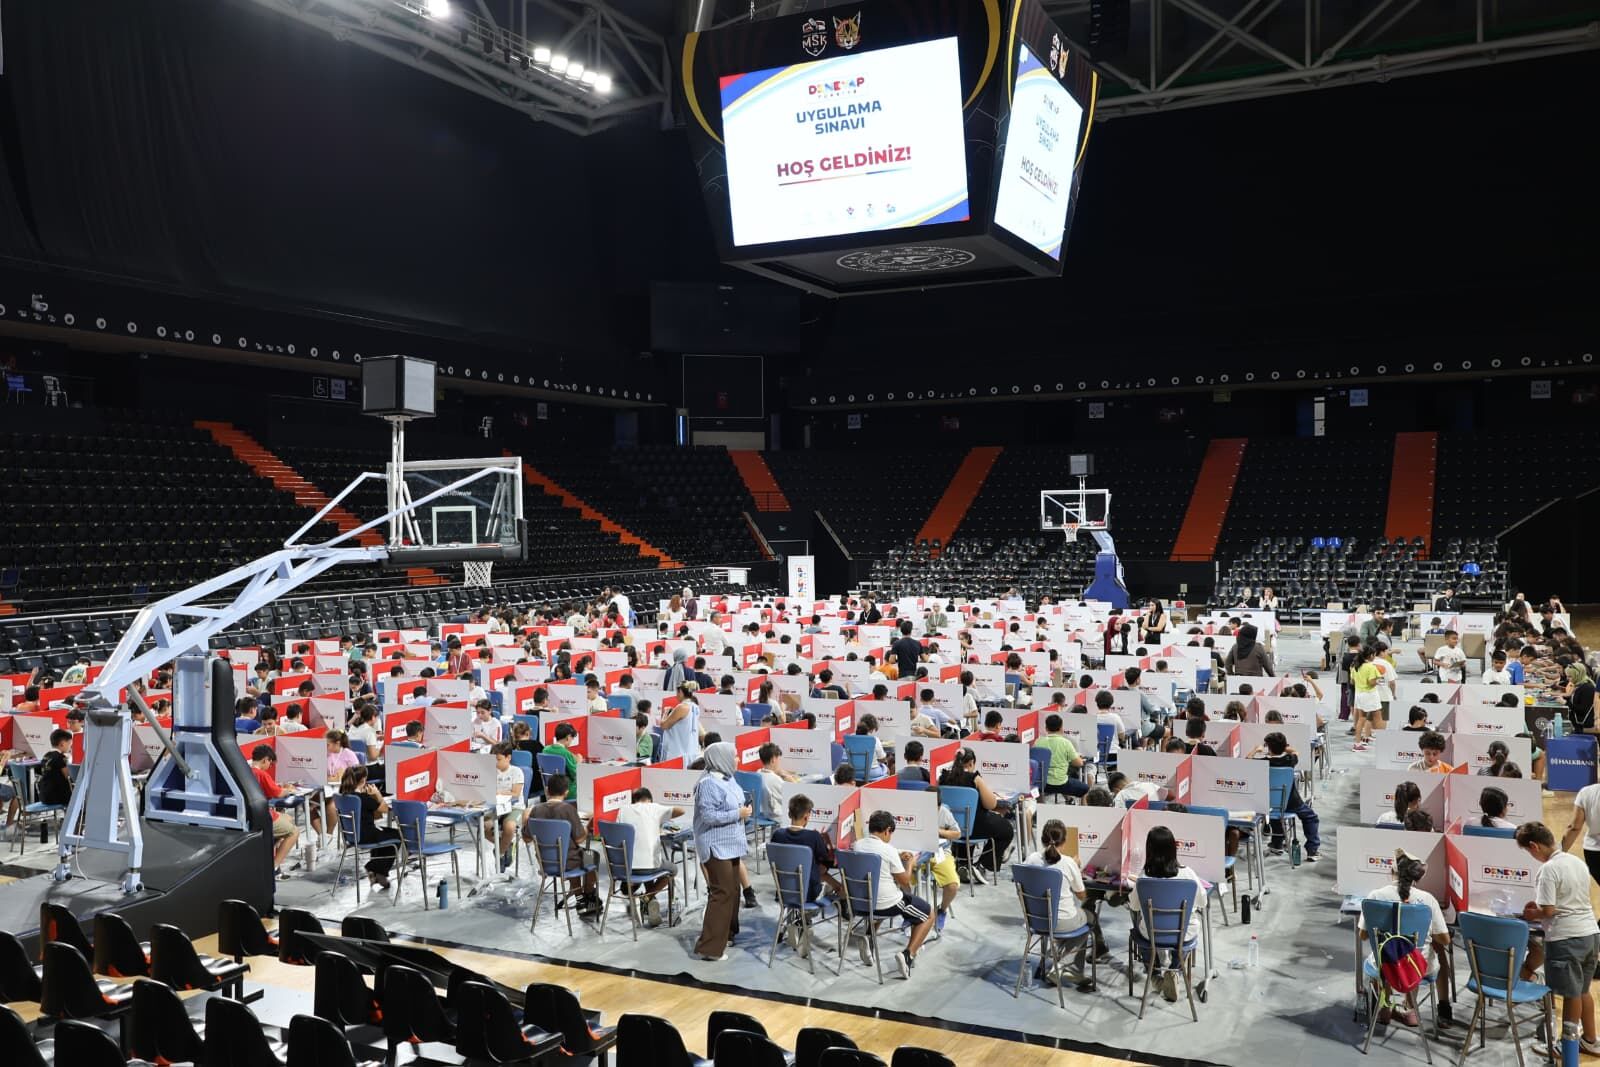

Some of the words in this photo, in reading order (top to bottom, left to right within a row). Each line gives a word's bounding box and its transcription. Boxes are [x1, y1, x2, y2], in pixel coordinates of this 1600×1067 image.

[802, 35, 827, 49] MSK
[796, 100, 882, 123] UYGULAMA
[815, 117, 865, 135] SINAVI
[777, 160, 815, 177] HOŞ
[820, 144, 912, 171] GELDİNİZ!
[1175, 840, 1196, 848] EYAP
[1369, 857, 1393, 865] DENE
[1484, 867, 1529, 877] DENEYAP
